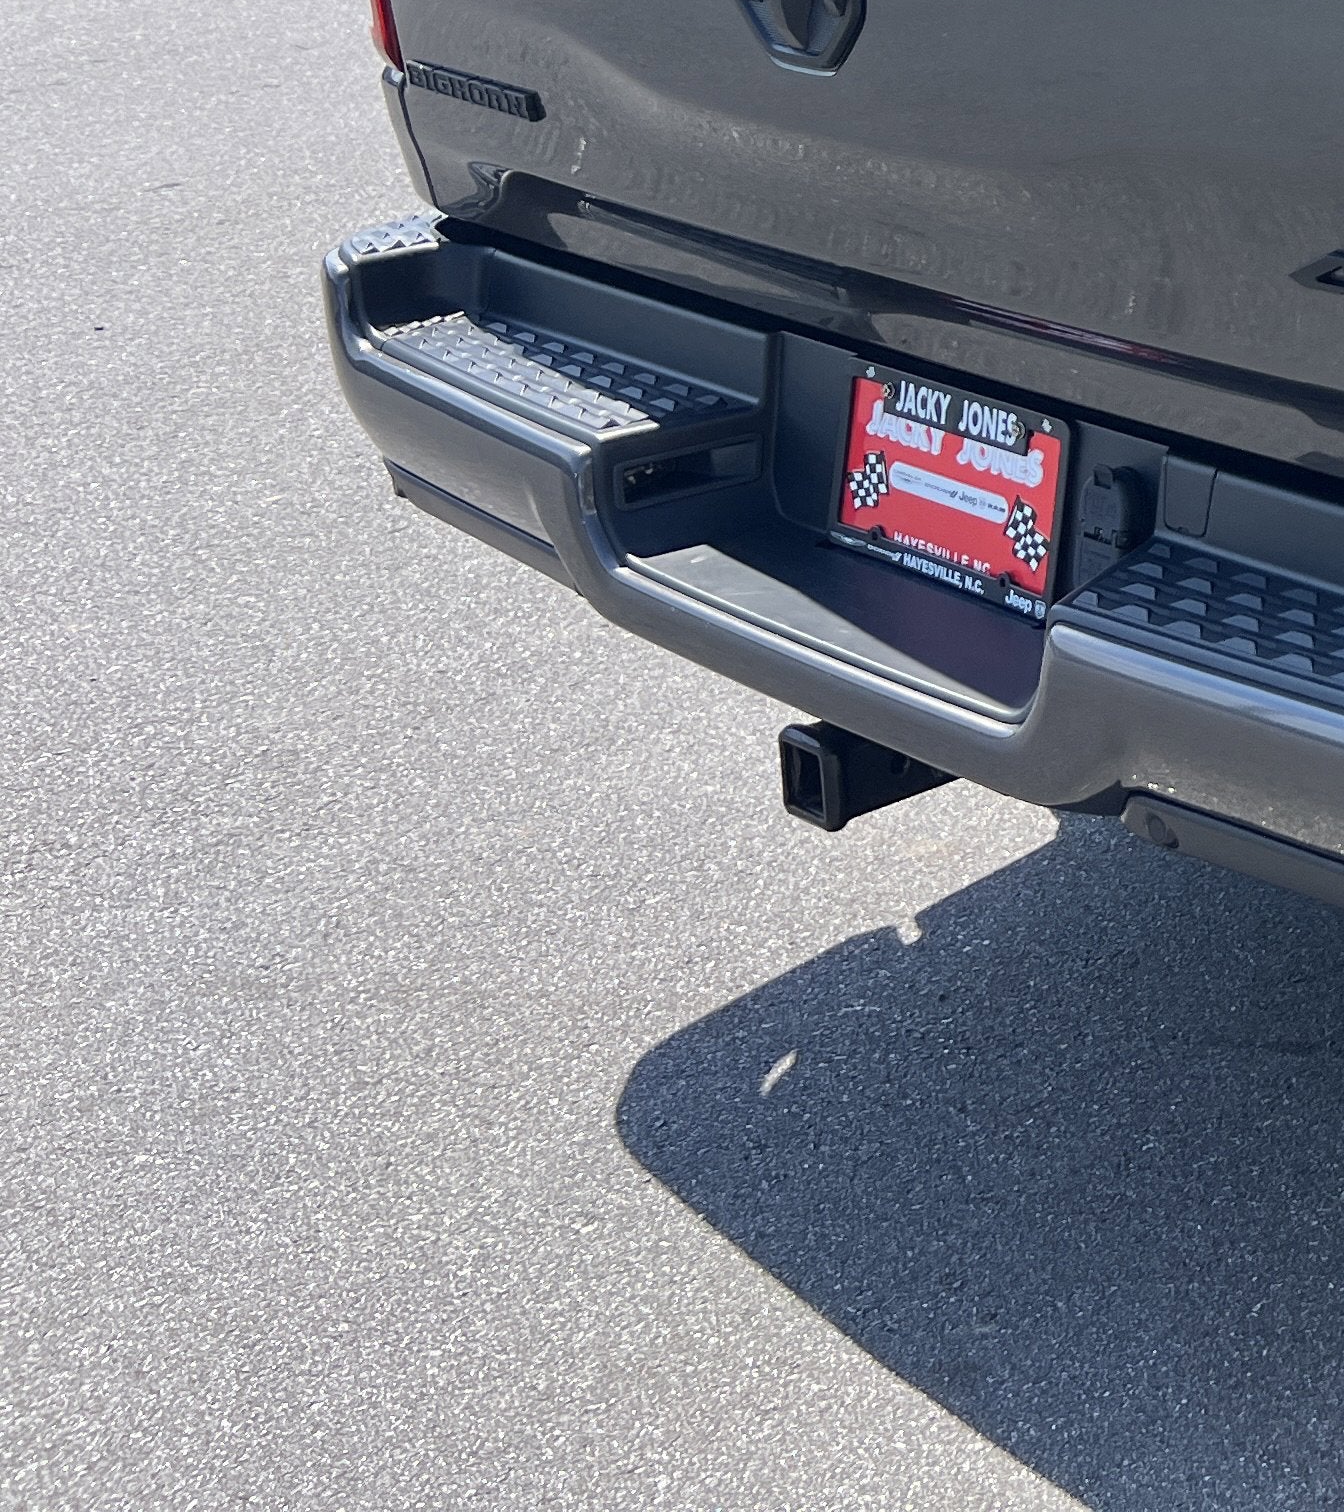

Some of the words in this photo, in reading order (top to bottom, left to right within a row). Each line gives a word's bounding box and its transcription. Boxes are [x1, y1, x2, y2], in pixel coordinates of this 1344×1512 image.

[896, 380, 952, 425] JACKY
[958, 399, 1018, 446] JONES
[1005, 589, 1032, 613] Jeep
